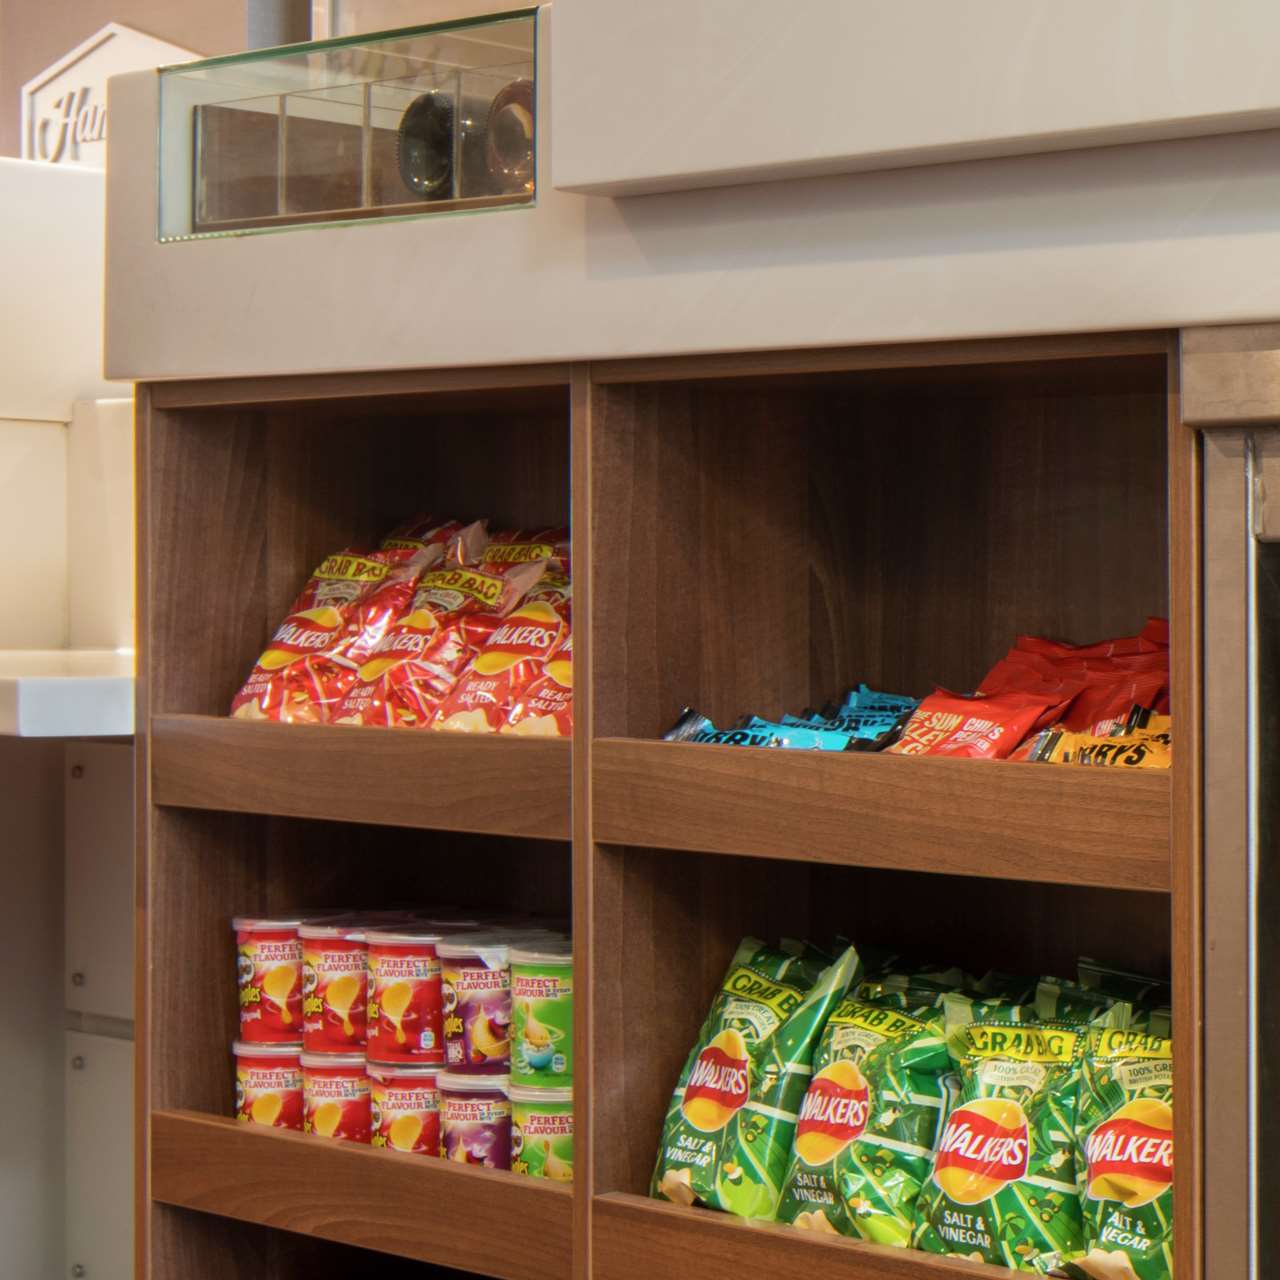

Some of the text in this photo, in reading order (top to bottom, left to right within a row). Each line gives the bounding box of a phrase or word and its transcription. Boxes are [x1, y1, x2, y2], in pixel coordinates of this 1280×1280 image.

[271, 622, 336, 648] WALKERS
[487, 623, 556, 648] WALKERS
[924, 711, 963, 731] SUN
[260, 943, 303, 953] PERFEC
[324, 954, 368, 963] PERFEC
[463, 971, 506, 981] PERFEC
[732, 974, 781, 999] GRAB
[837, 1003, 886, 1028] GRAB
[690, 1058, 747, 1095] WALKERS
[1128, 1067, 1153, 1077] 100%
[530, 1115, 573, 1124] PERFEC
[800, 1090, 868, 1127] WALKERS
[677, 1134, 712, 1152] SALT &
[940, 1122, 1028, 1166] WALKERS
[1086, 1130, 1173, 1168] WALKER
[666, 1146, 711, 1167] VINEGAR
[796, 1173, 818, 1188] SALT
[792, 1187, 835, 1205] VINEGAR
[943, 1209, 986, 1231] SALT &
[1109, 1211, 1147, 1235] ALT &
[937, 1223, 993, 1248] VINEGAR
